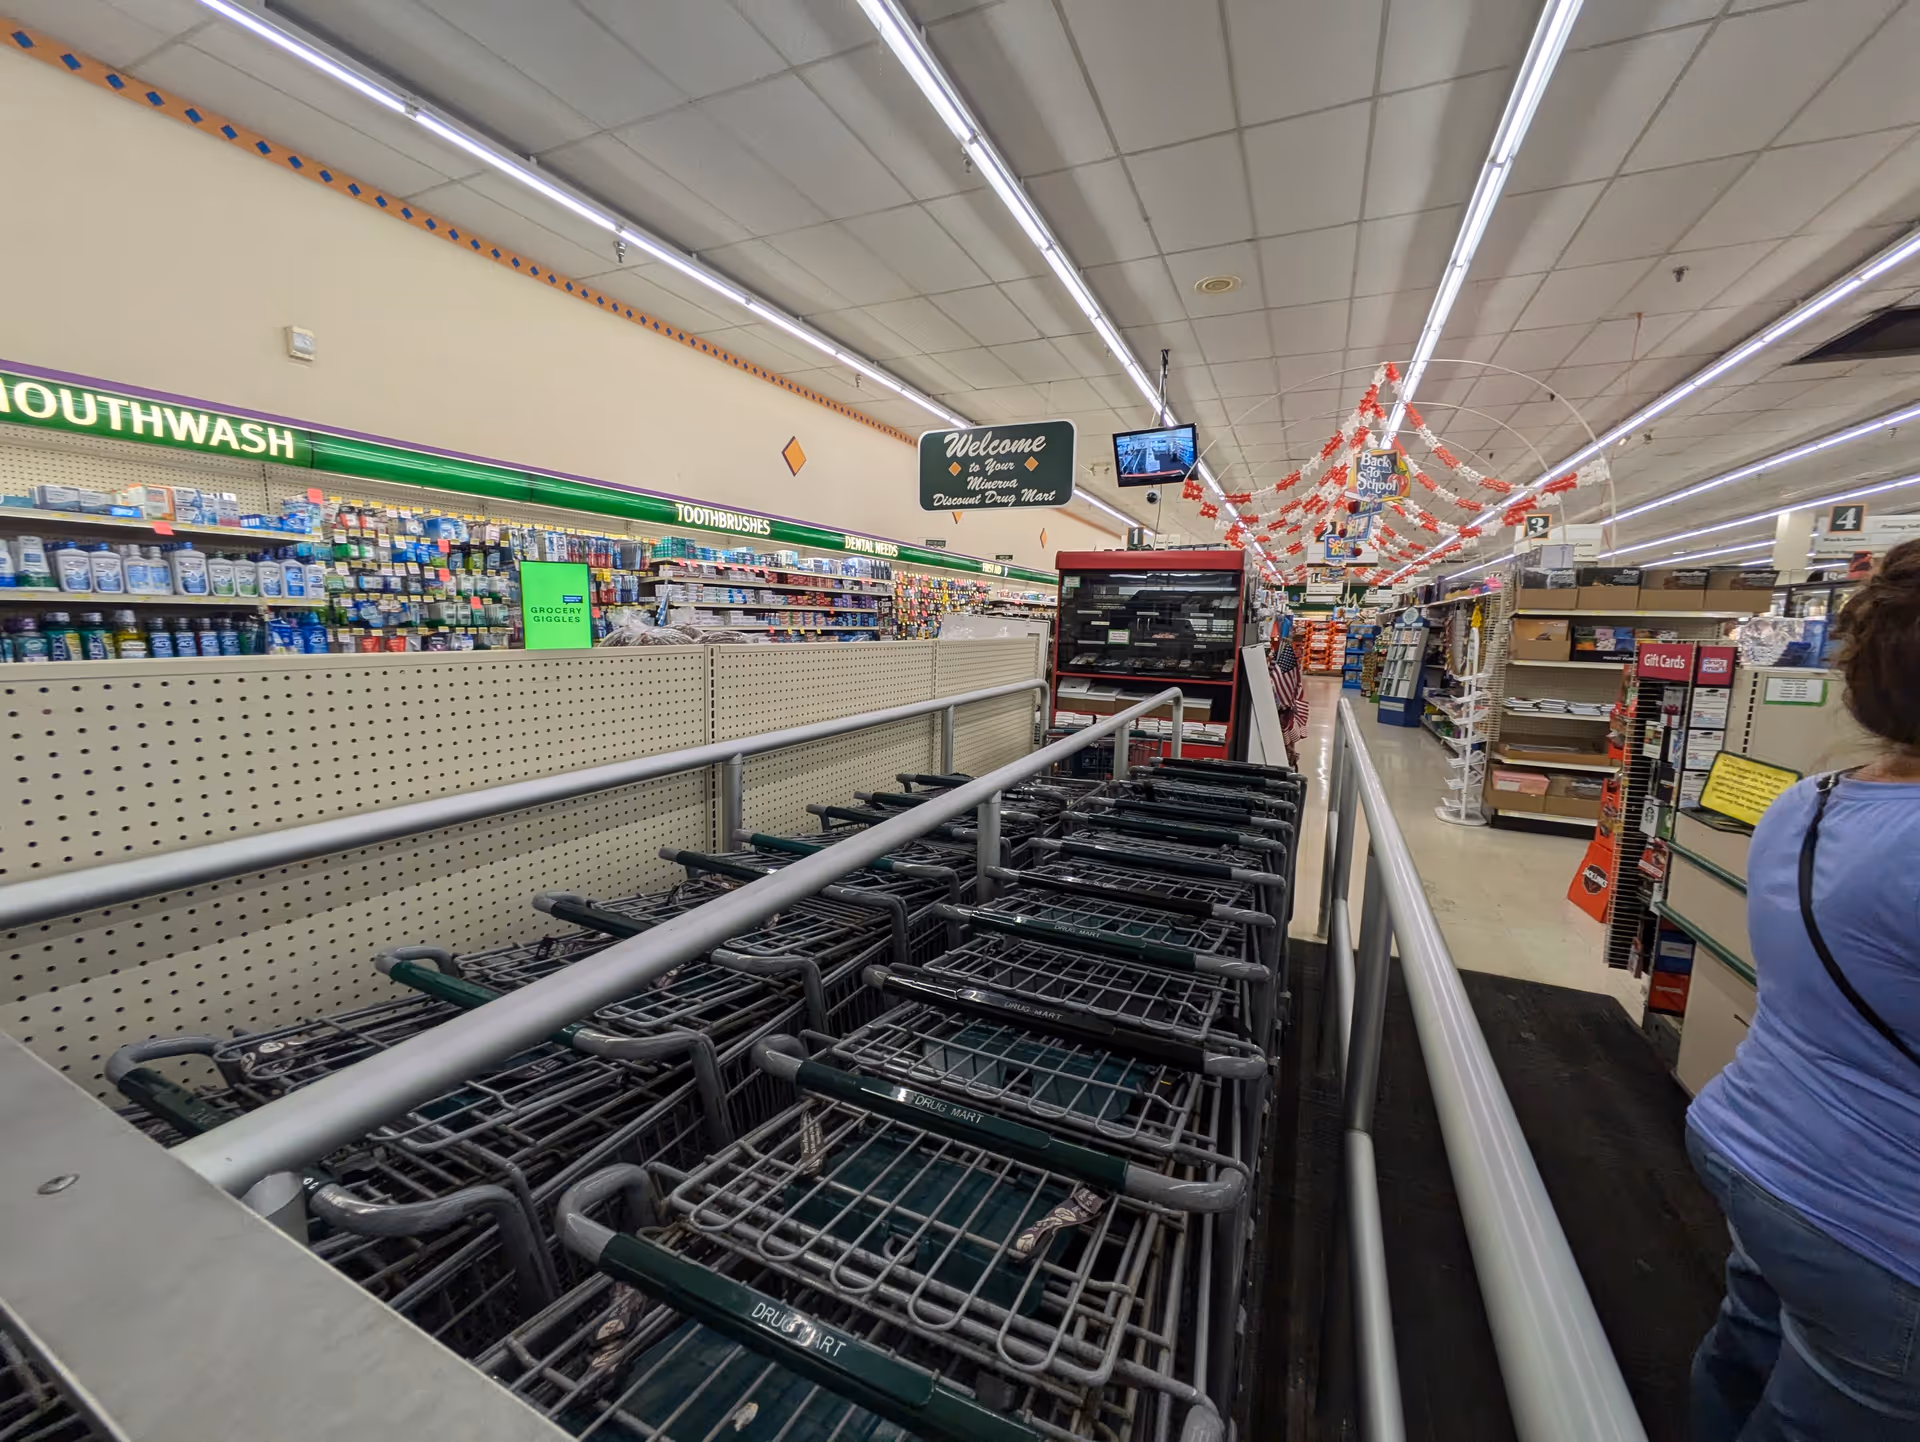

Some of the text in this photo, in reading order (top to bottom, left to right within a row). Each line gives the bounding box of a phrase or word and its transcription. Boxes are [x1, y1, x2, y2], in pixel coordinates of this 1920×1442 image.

[943, 430, 1047, 458] Welcome
[968, 458, 1015, 476] to Your
[1361, 452, 1389, 467] Back
[1367, 466, 1380, 478] To
[966, 476, 1019, 491] Minerva
[1357, 471, 1397, 494] School
[932, 488, 1057, 507] Discount Drug Mart
[674, 503, 771, 535] TOOTHBRUSHES
[1529, 517, 1545, 535] 3
[1835, 508, 1857, 529] 4
[1132, 528, 1139, 545] 1
[844, 535, 898, 557] DENTAL NEEDS
[530, 606, 582, 614] GROCERY
[533, 615, 580, 623] GIGGLES
[1644, 653, 1685, 669] Gift Cards
[1079, 929, 1101, 938] MART
[1004, 1001, 1063, 1020] DRUG MART
[914, 1095, 984, 1124] DRUG MART
[751, 1302, 847, 1357] DRUG MART
